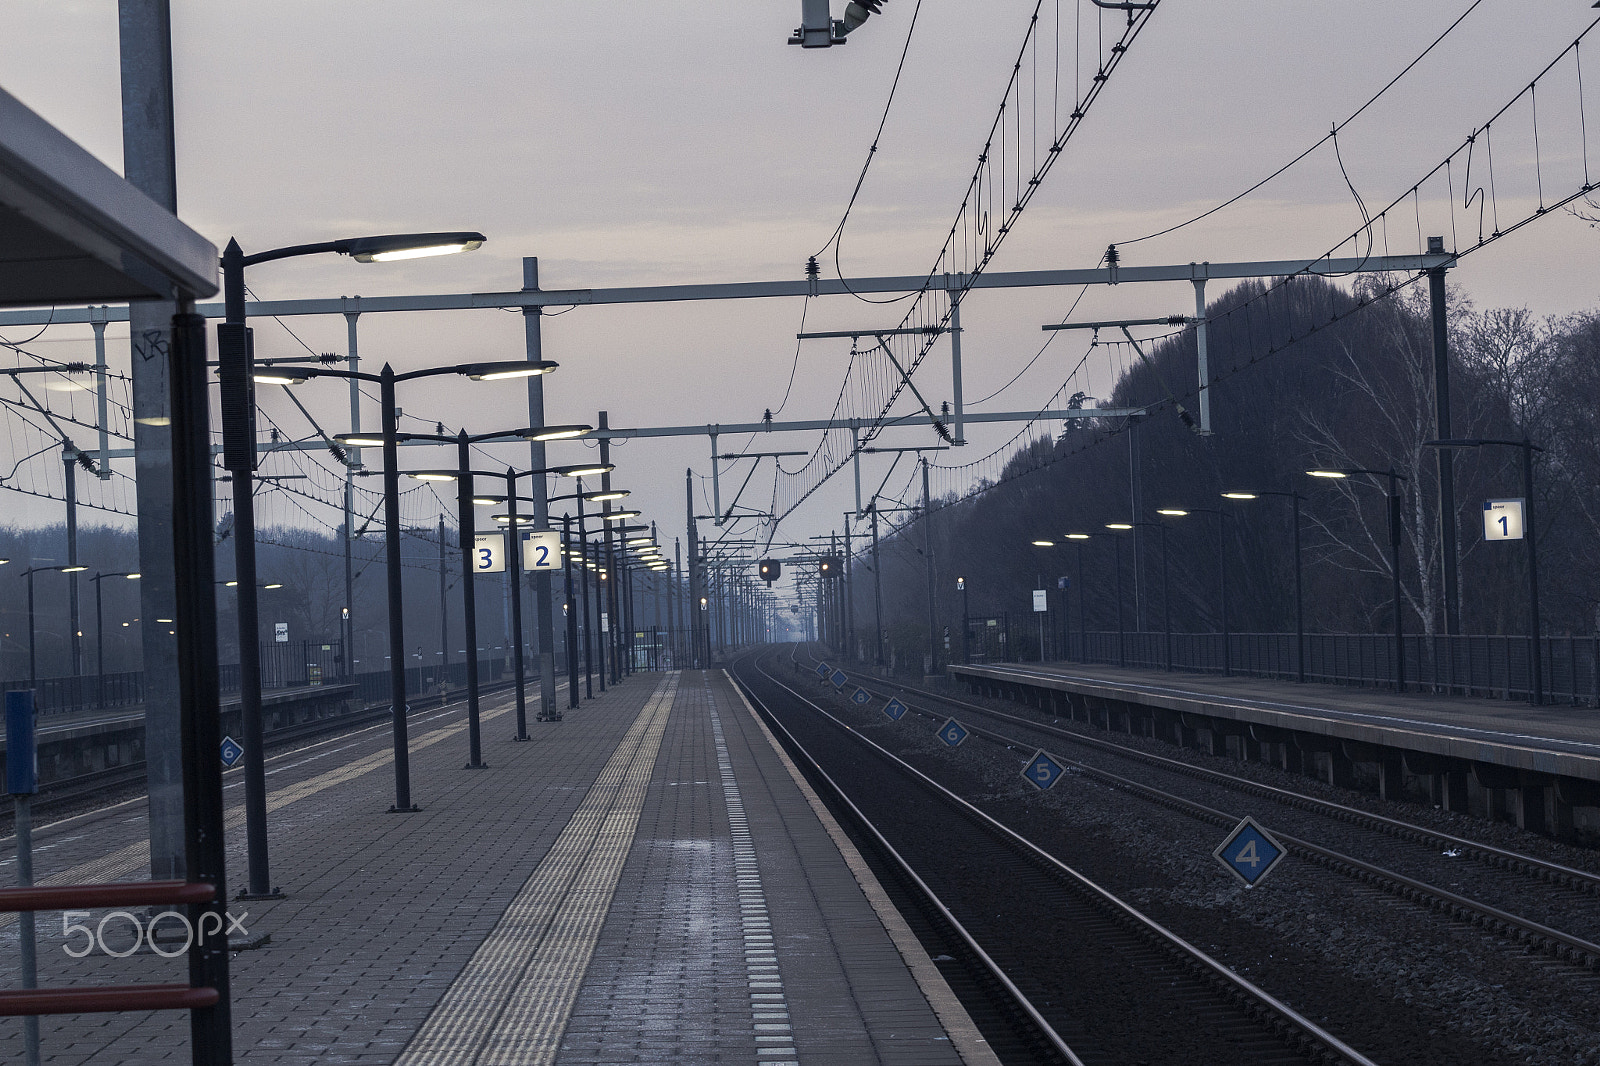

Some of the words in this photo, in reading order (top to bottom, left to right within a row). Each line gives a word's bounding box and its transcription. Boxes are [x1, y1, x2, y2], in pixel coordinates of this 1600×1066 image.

[1498, 516, 1508, 536] 1
[479, 548, 492, 569] 3
[536, 546, 550, 566] 2
[857, 693, 864, 702] 8
[890, 704, 899, 715] 7
[947, 728, 957, 741] 6
[223, 747, 234, 759] 6
[1036, 763, 1050, 781] 5
[1235, 840, 1260, 867] 4
